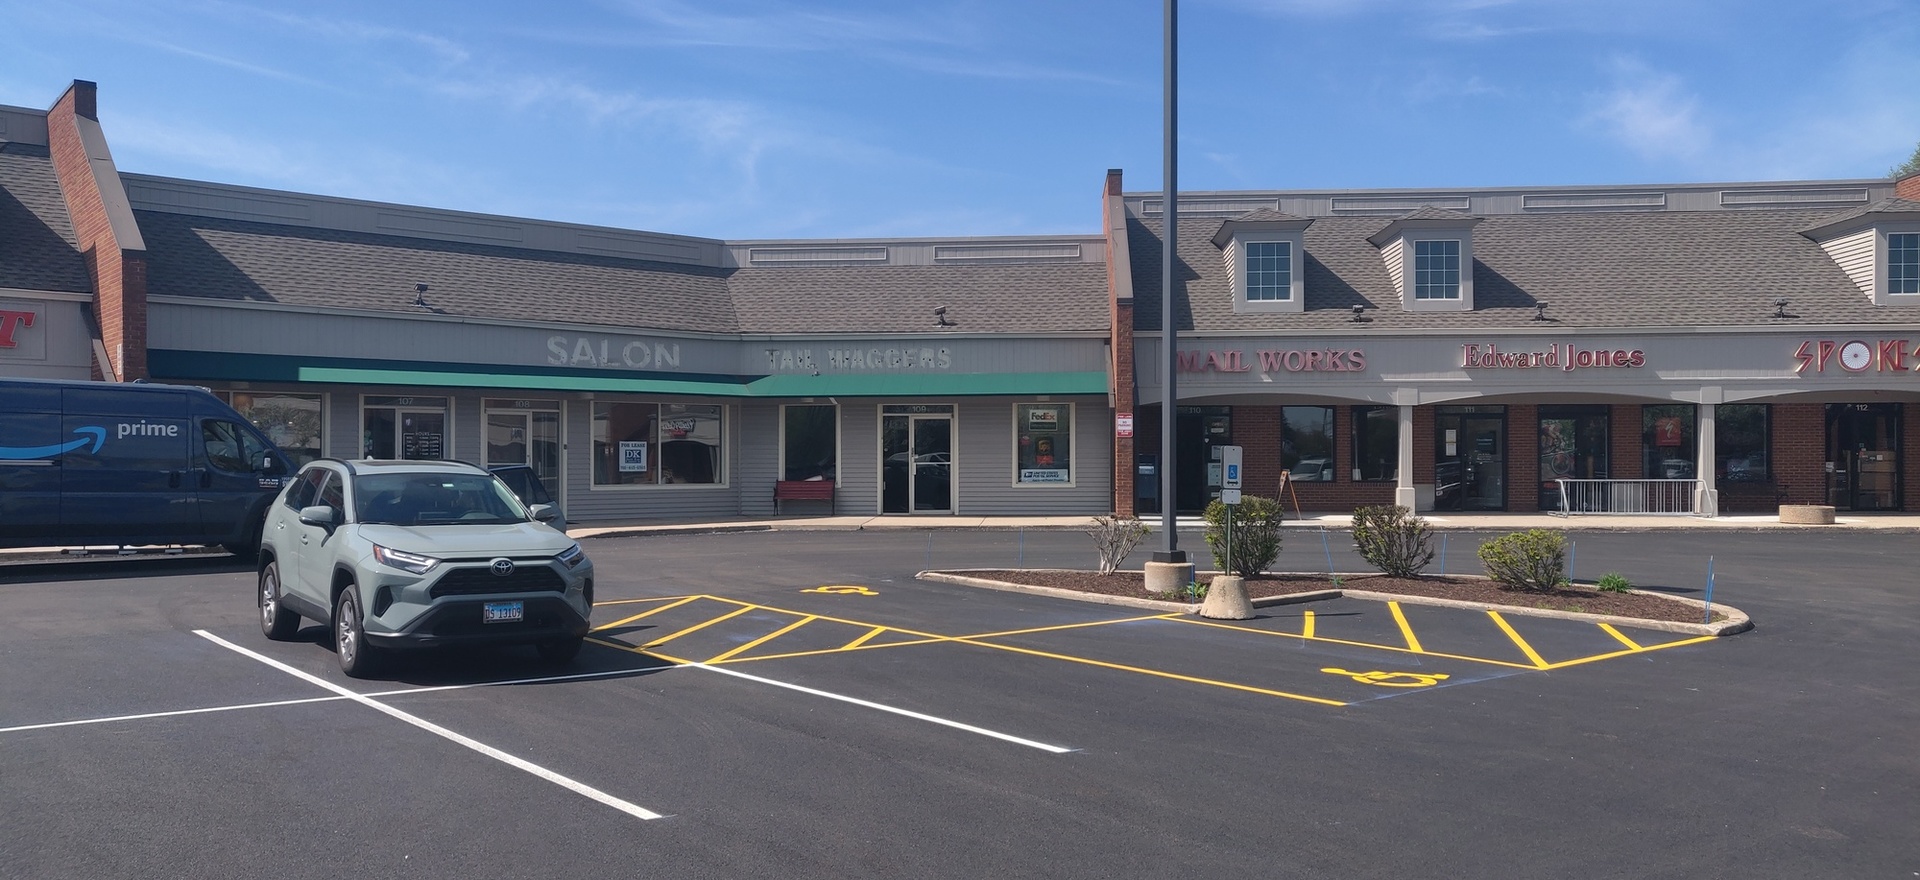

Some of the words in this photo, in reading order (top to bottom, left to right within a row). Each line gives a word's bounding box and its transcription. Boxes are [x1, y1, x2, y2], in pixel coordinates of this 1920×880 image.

[547, 336, 680, 369] SALON
[765, 349, 818, 370] TAIL
[828, 347, 951, 370] WAGGERS
[1176, 350, 1252, 373] MAIL
[1257, 348, 1367, 373] WORKS
[1461, 343, 1561, 369] Edward
[1563, 343, 1646, 371] Jones
[399, 397, 414, 405] 107
[515, 400, 530, 408] 108
[912, 405, 927, 413] 109
[1189, 406, 1201, 414] 110
[1464, 405, 1475, 413] 111
[1031, 412, 1055, 420] FedEx
[118, 419, 178, 439] prime
[626, 450, 640, 458] DK
